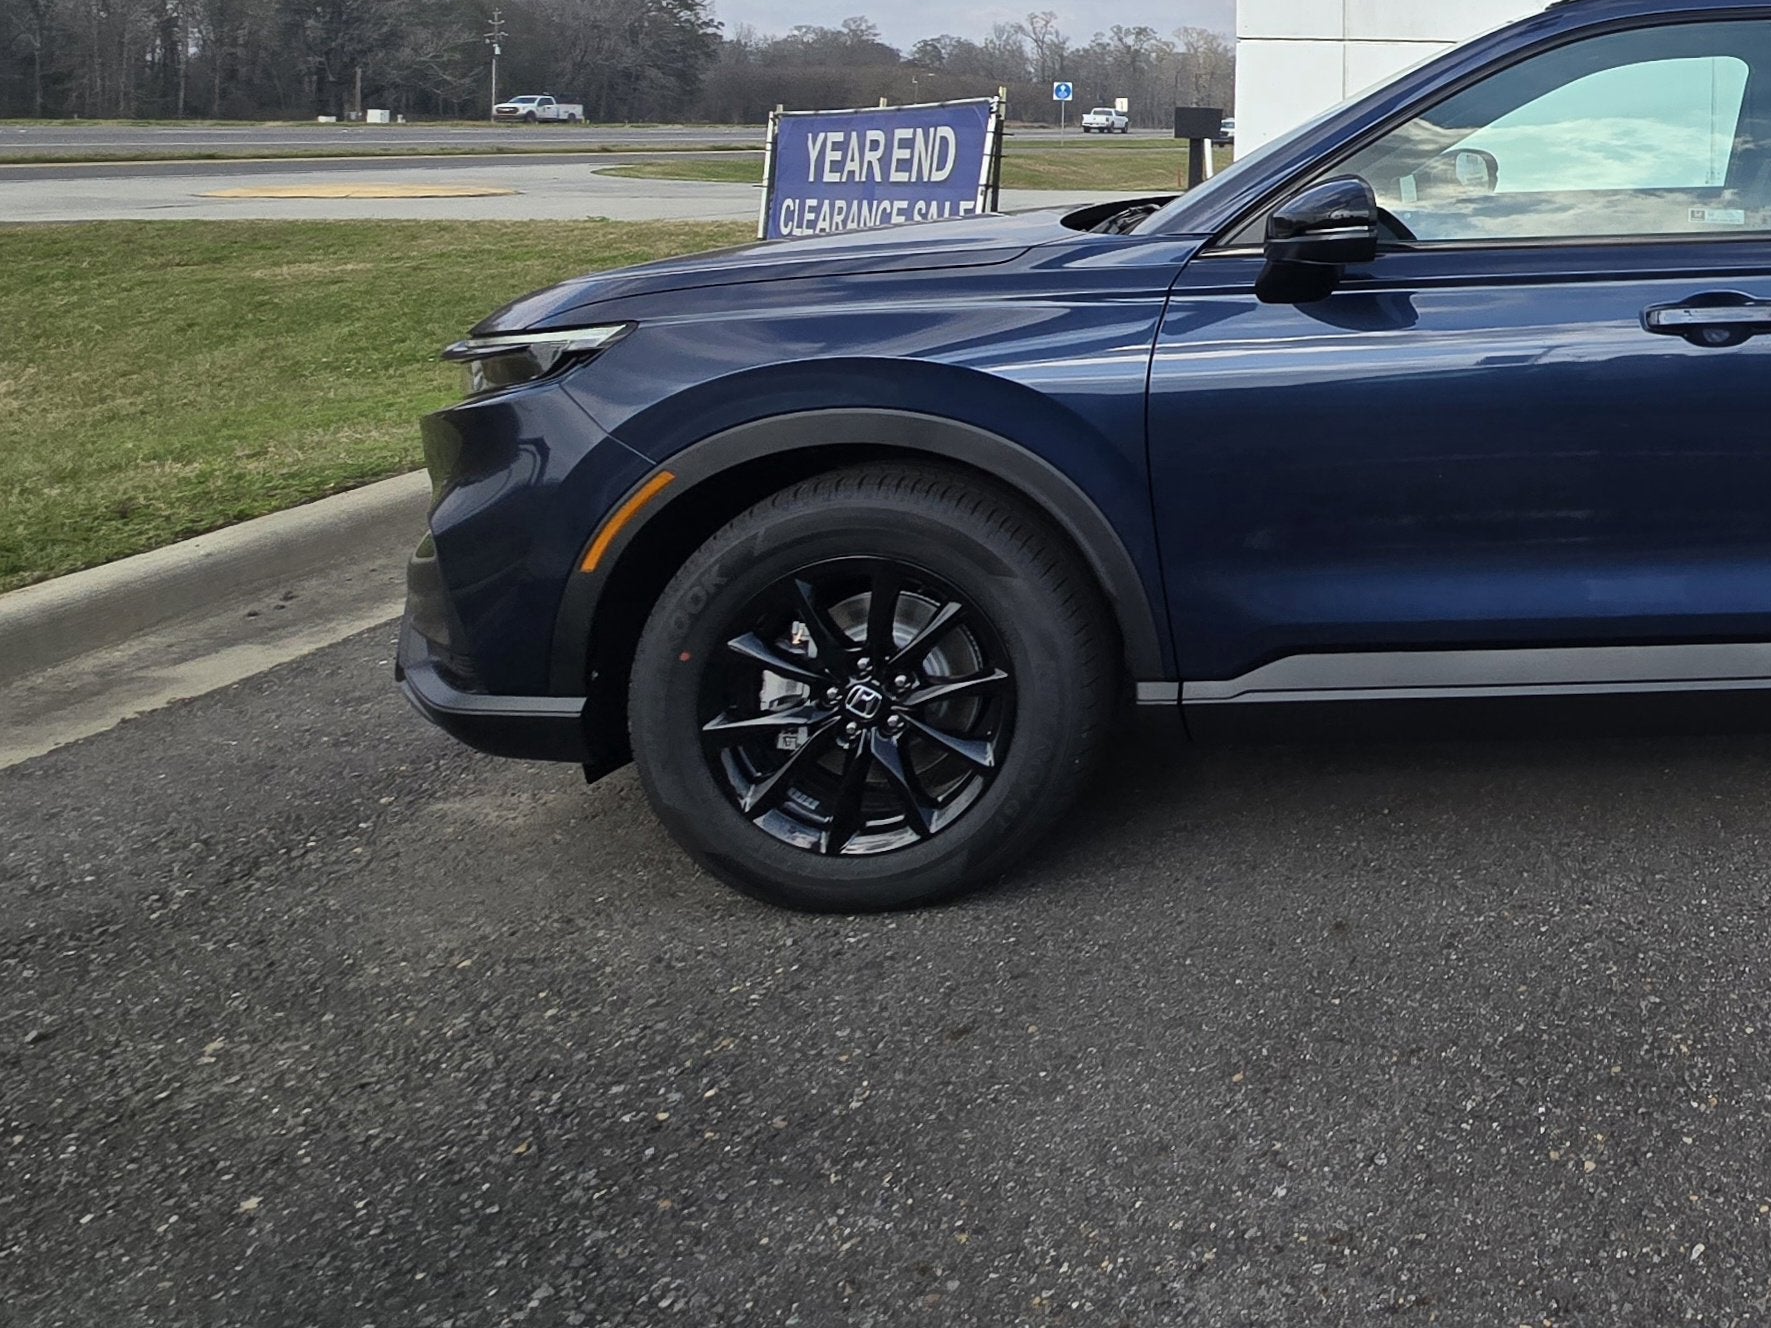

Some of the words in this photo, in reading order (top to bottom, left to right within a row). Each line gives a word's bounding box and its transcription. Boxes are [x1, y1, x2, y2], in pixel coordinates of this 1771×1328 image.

[807, 129, 886, 183] YEAR
[889, 126, 957, 183] END
[779, 198, 909, 237] CLEARANCE
